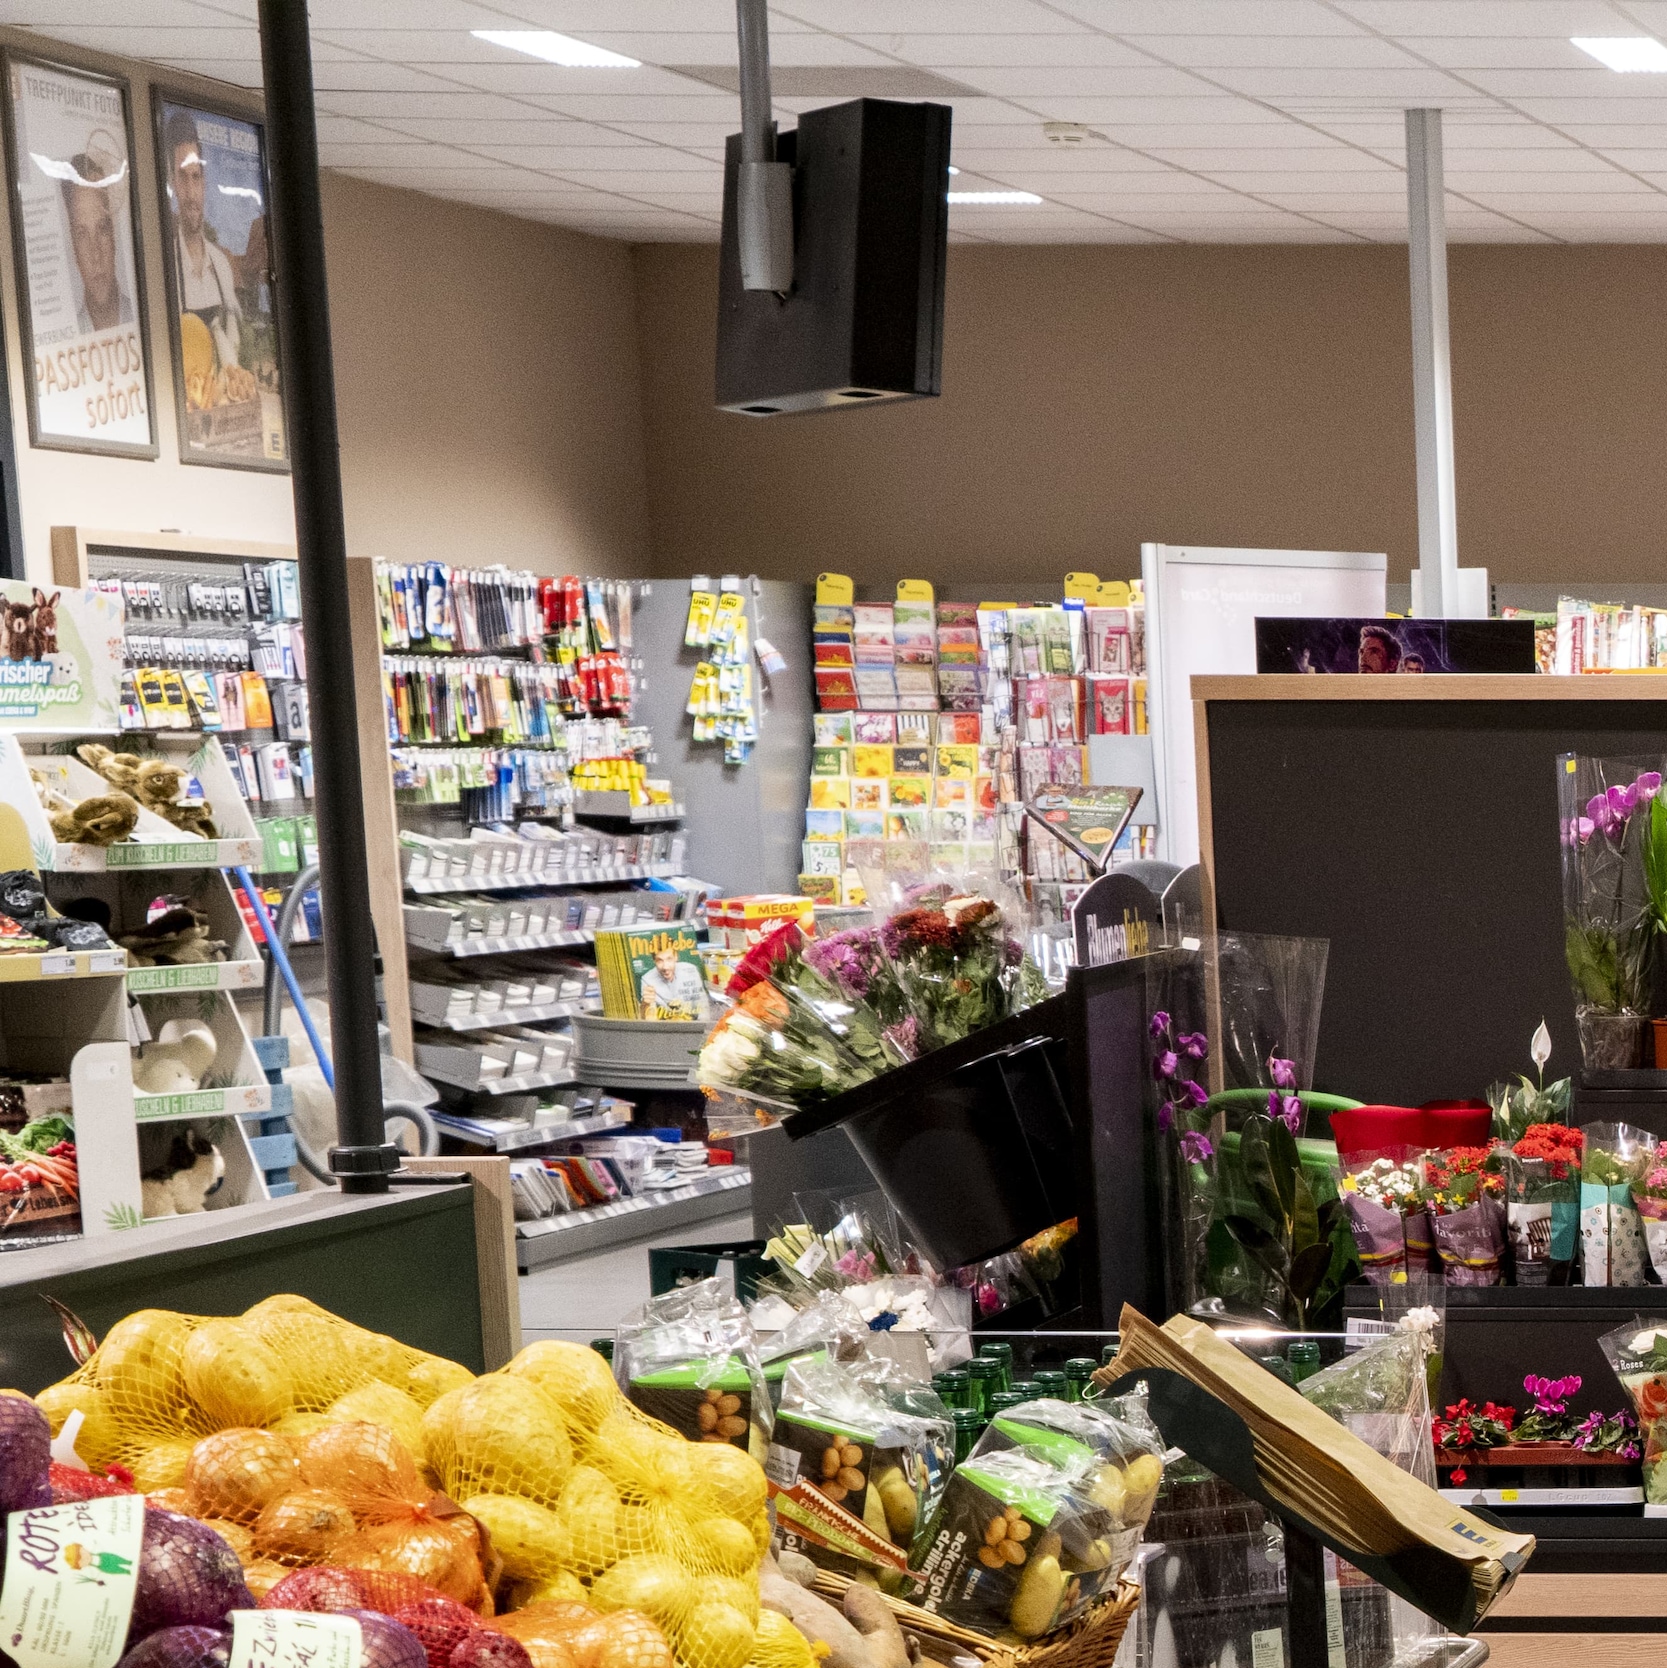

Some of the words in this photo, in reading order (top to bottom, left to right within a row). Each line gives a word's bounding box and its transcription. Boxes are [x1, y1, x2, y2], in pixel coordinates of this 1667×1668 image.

[26, 76, 93, 108] TREFFPUNKT
[93, 90, 121, 117] FOTO
[36, 332, 141, 396] PASSFOTOS
[85, 382, 145, 428] sofort
[758, 903, 798, 914] MEGA
[1620, 1359, 1643, 1372] Roses
